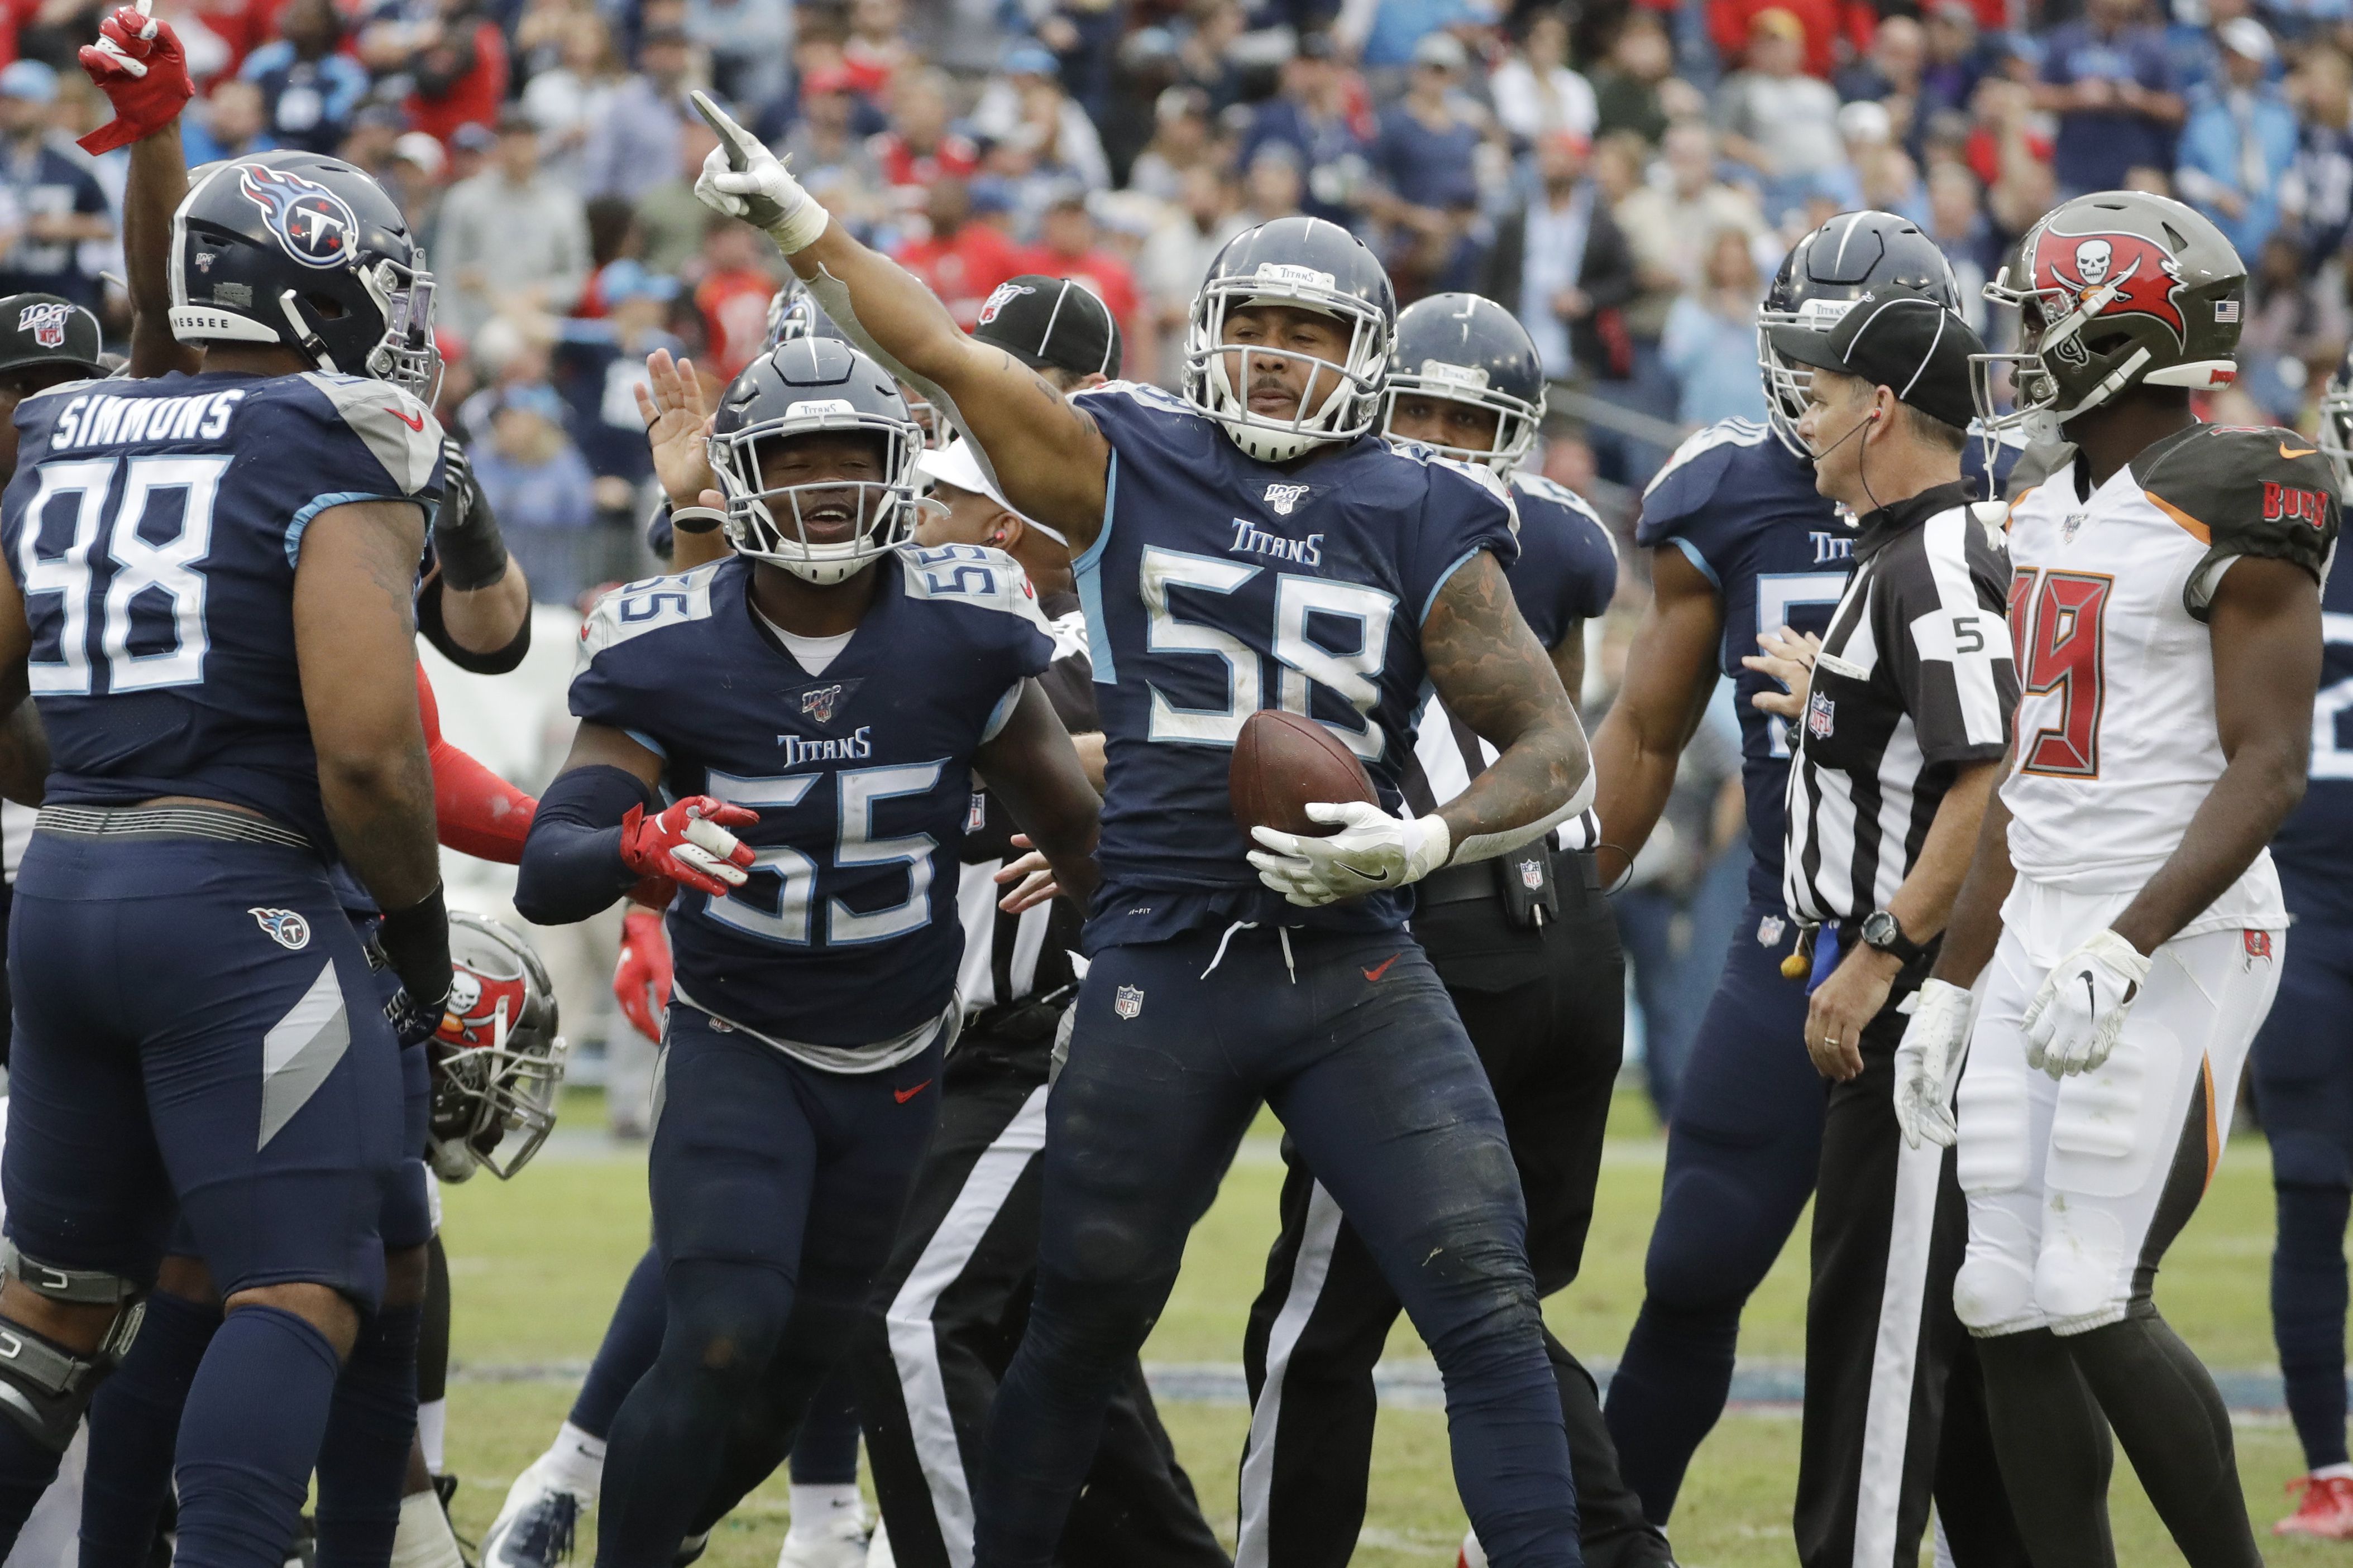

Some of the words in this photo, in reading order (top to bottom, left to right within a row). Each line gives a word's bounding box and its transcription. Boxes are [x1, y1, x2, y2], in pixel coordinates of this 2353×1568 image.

[172, 317, 229, 328] NESSEE
[51, 389, 246, 450] SIMMONS
[1229, 517, 1325, 568] TITANS
[1809, 531, 1854, 563] TIT
[18, 454, 235, 696] 98
[1139, 544, 1400, 764] 58
[1952, 616, 1984, 654] 5
[1811, 710, 1831, 732] NFL
[777, 726, 872, 768] TITANS
[702, 756, 953, 946] 55
[1524, 872, 1541, 885] NFL
[1118, 999, 1136, 1014] NFL
